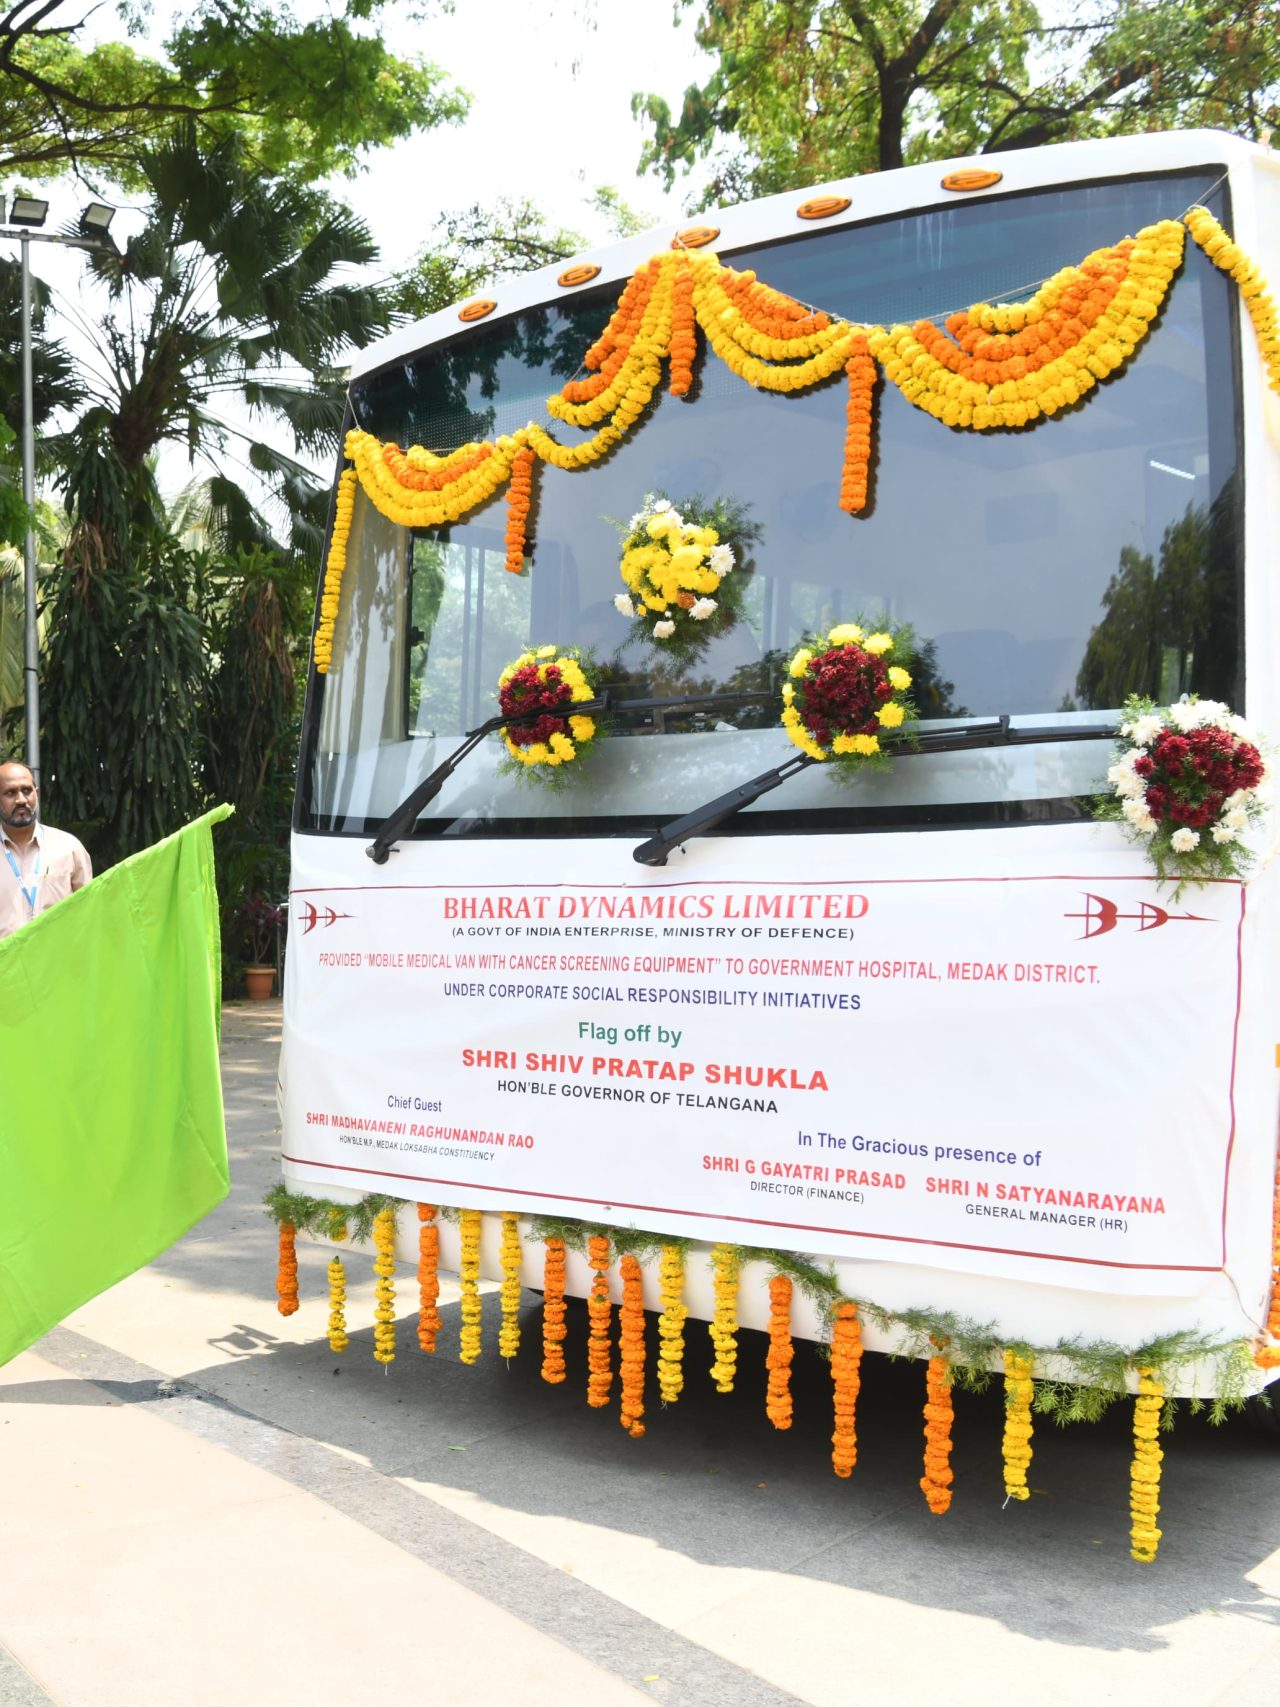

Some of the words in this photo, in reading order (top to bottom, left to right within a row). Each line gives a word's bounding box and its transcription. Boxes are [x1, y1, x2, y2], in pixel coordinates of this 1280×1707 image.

[443, 896, 551, 919] BHARAT
[558, 895, 715, 919] DYNAMICS
[723, 894, 869, 919] LIMITED
[452, 927, 465, 938] (A
[467, 926, 502, 937] GOVT
[505, 926, 522, 937] OF
[526, 926, 562, 937] INDIA
[564, 926, 658, 938] ENTERPRISE,
[662, 927, 737, 938] MINISTRY
[740, 927, 763, 938] OF
[768, 927, 855, 942] DEFENCE)
[319, 952, 362, 967] PROVIDED
[407, 953, 452, 969] MEDICAL
[455, 954, 476, 969] VAN
[478, 954, 506, 969] WITH
[509, 954, 557, 971] CANCER
[559, 955, 630, 972] SCREENING
[725, 957, 744, 975] TO
[748, 958, 855, 977] GOVERNMENT
[858, 960, 942, 980] HOSPITAL,
[947, 962, 1008, 981] MEDAK
[1014, 963, 1100, 984] DISTRICT.
[444, 982, 485, 998] UNDER
[488, 983, 569, 1000] CORPORATE
[572, 985, 624, 1002] SOCIAL
[627, 987, 759, 1007] RESPONSIBILITY
[762, 991, 861, 1011] INITIATIVES
[578, 1021, 618, 1046] Flag
[623, 1023, 652, 1043] off
[657, 1025, 683, 1049] by
[462, 1048, 517, 1070] SHRI
[525, 1052, 584, 1074] SHIV
[592, 1056, 695, 1082] PRATAP
[704, 1063, 829, 1092] SHUKLA
[387, 1094, 412, 1110] Chief
[413, 1097, 442, 1113] Guest
[561, 1084, 646, 1104] GOVERNOR
[649, 1091, 672, 1105] OF
[675, 1092, 779, 1114] TELANGANA
[306, 1111, 329, 1126] SHRI
[331, 1115, 407, 1135] MADHAVANENI
[409, 1123, 505, 1146] RAGHUNANDAN
[507, 1133, 535, 1149] RAO
[376, 1139, 399, 1150] MEDAK
[399, 1143, 438, 1155] LOKSABHA
[439, 1147, 495, 1161] CONSTITUENCY
[798, 1130, 812, 1147] In
[817, 1132, 847, 1150] The
[851, 1135, 929, 1157] Gracious
[934, 1145, 1017, 1165] presence
[1022, 1150, 1043, 1167] of
[702, 1154, 739, 1173] SHRI
[744, 1159, 756, 1175] G
[760, 1160, 829, 1182] GAYATRI
[835, 1167, 906, 1190] PRASAD
[750, 1180, 804, 1196] DIRECTOR
[806, 1187, 865, 1205] (FINANCE)
[925, 1176, 970, 1197] SHRI
[976, 1181, 989, 1199] N
[995, 1183, 1166, 1214] SATYANARAYANA
[965, 1203, 1026, 1221] GENERAL
[1029, 1210, 1096, 1228] MANAGER
[1099, 1217, 1128, 1234] (HR)
